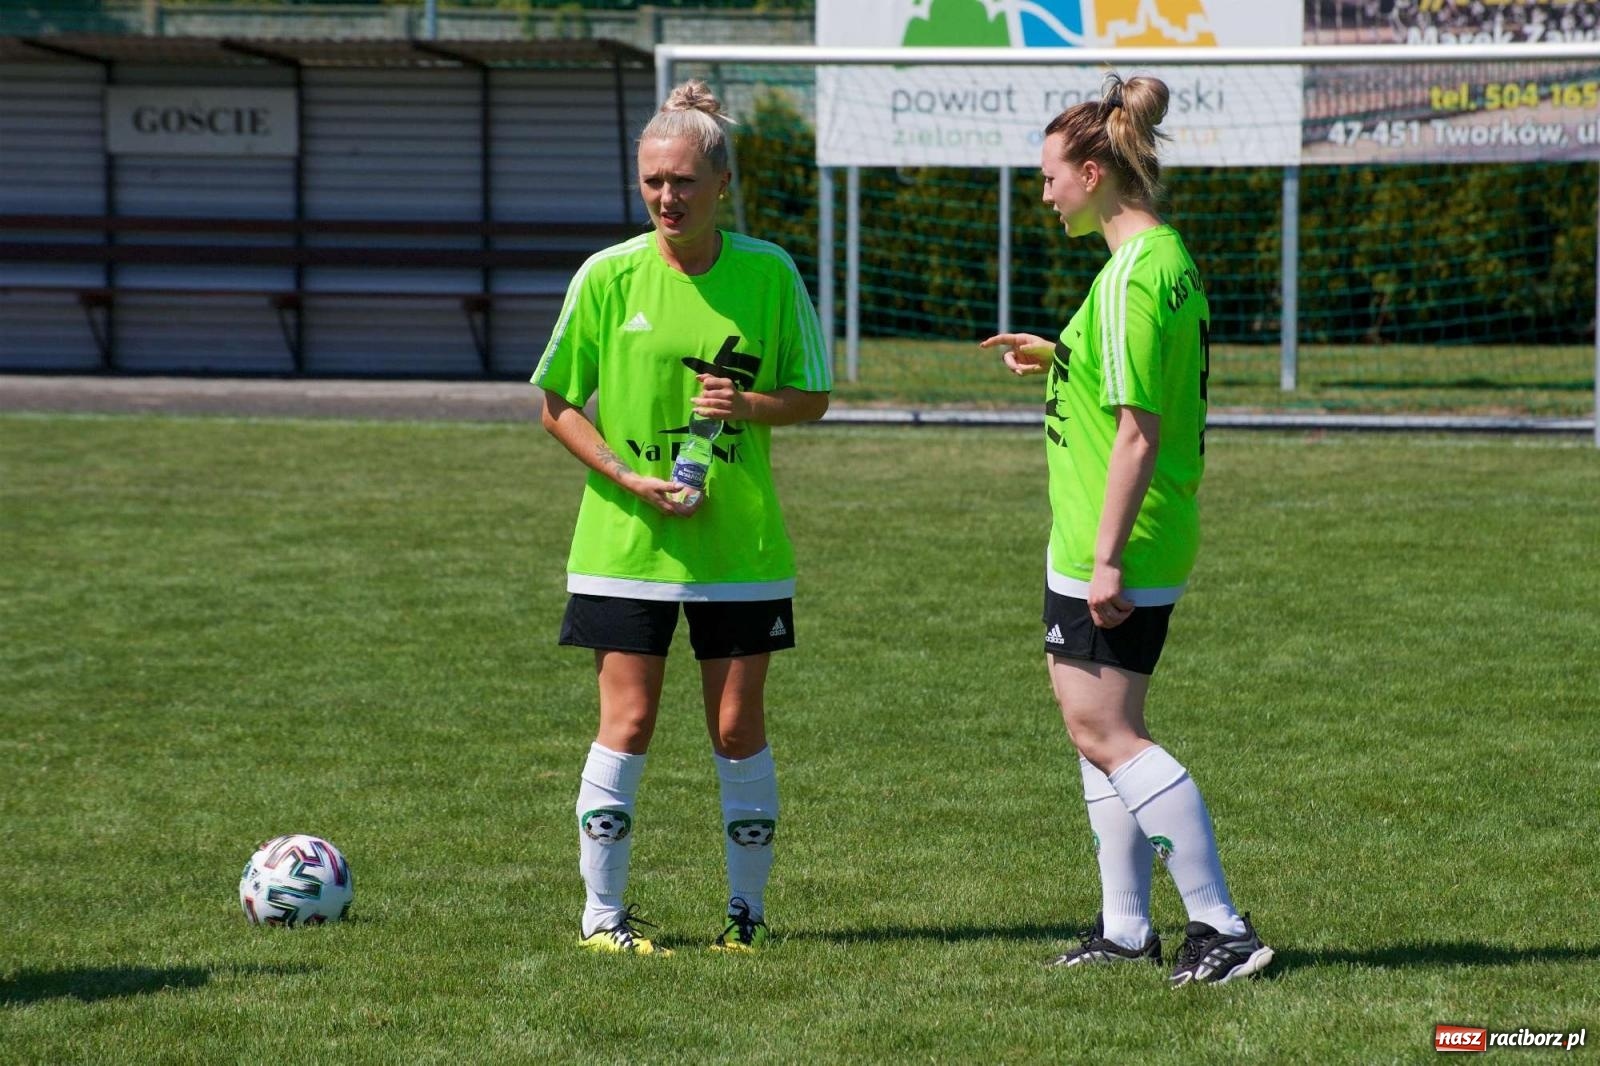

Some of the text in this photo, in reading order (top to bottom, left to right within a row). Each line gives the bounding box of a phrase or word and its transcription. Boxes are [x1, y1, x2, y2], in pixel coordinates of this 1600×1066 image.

[892, 77, 1225, 124] powiat racski
[1429, 81, 1599, 111] tel. 504 165
[132, 101, 272, 136] GOŚCIE
[1328, 120, 1421, 146] 47-451
[1429, 117, 1569, 148] Tworków,
[625, 439, 744, 464] Va NK
